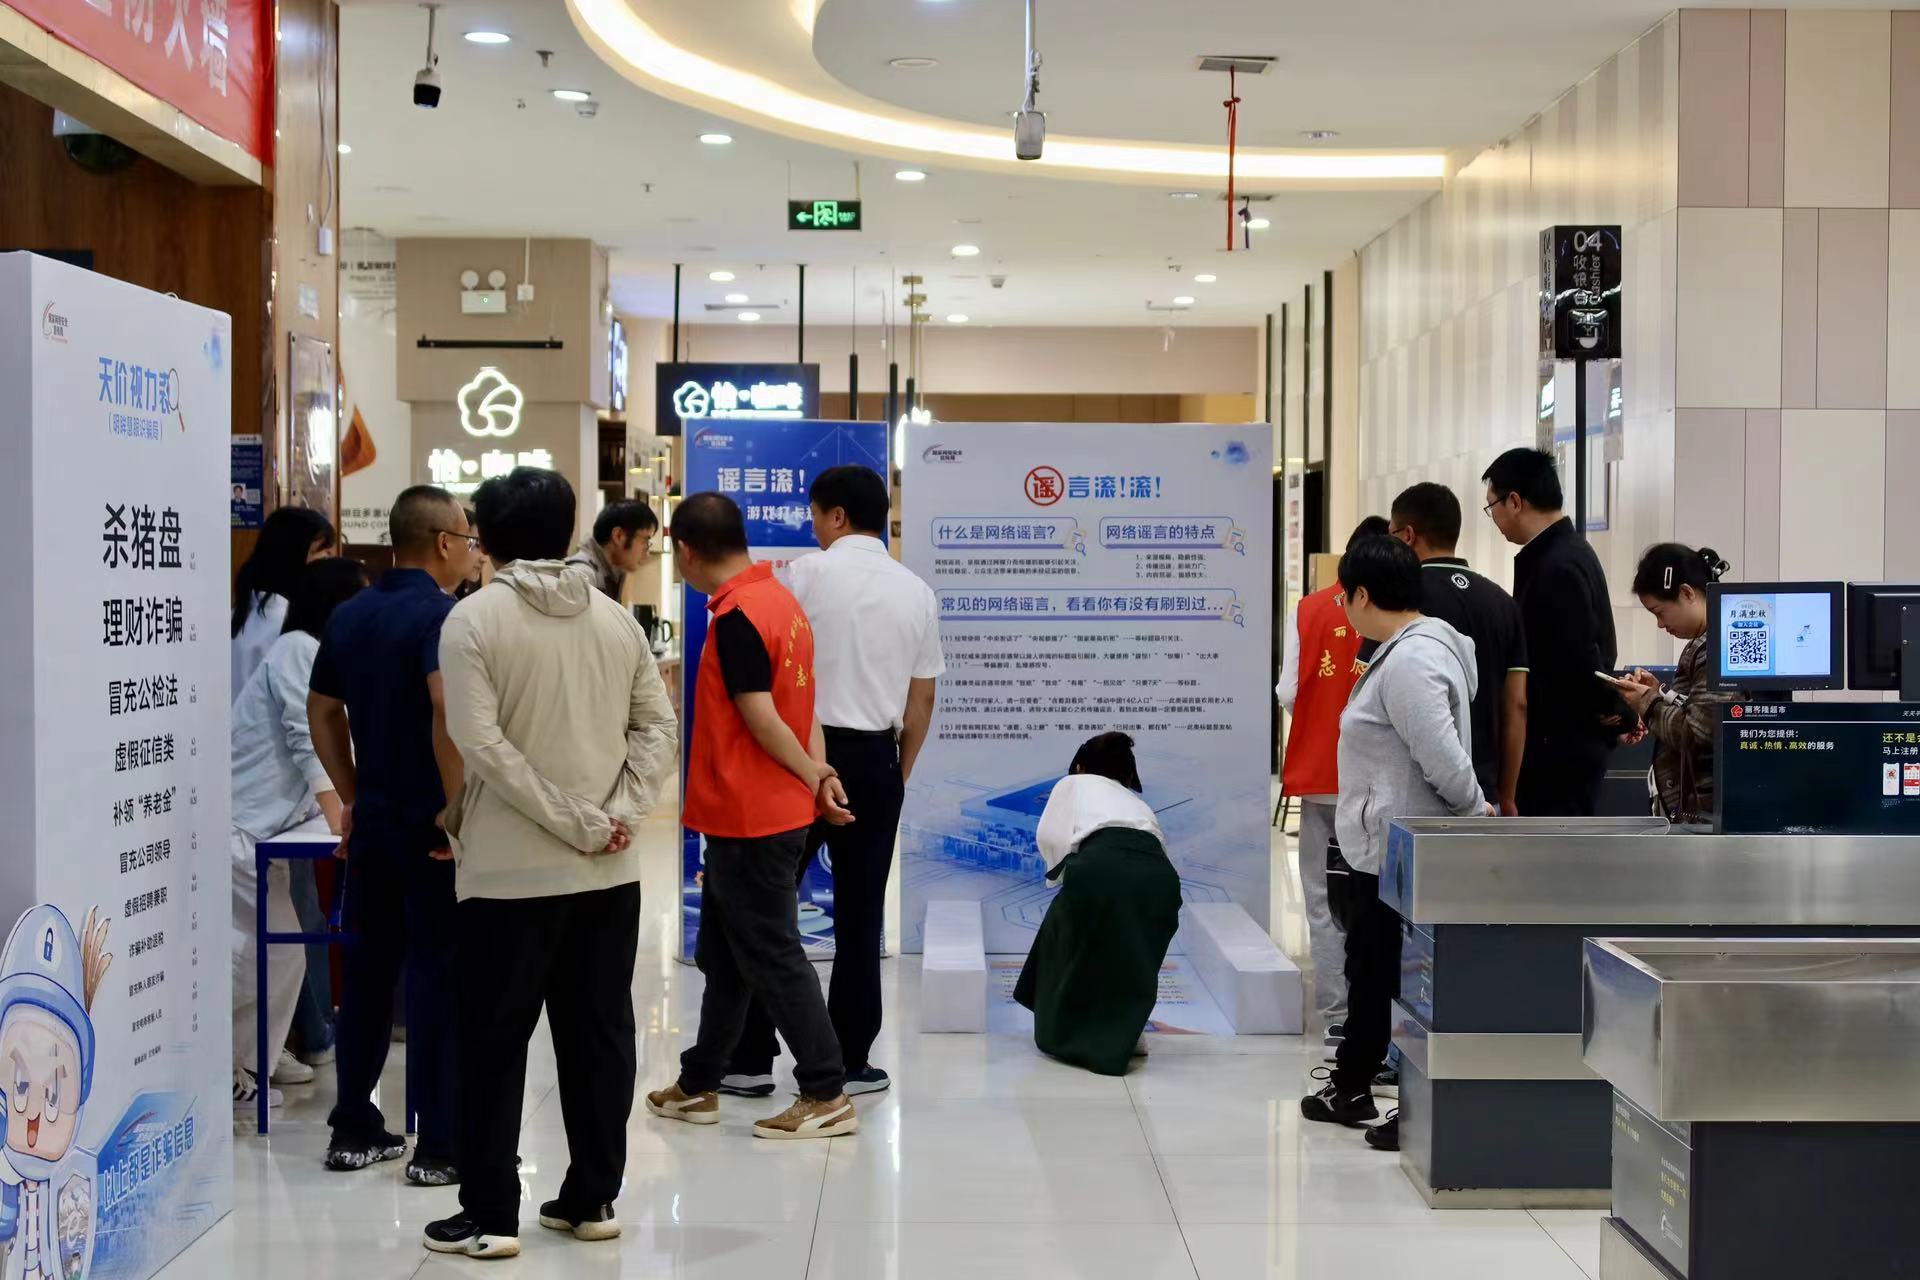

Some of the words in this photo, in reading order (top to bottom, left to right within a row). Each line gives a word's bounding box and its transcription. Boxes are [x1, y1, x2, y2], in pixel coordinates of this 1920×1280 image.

[1573, 230, 1602, 252] 04
[98, 357, 170, 414] 天价视力表
[717, 467, 805, 493] 谣言滚！
[102, 503, 182, 570] 杀猪盘
[938, 524, 1056, 540] 什么是网络谣言？
[1106, 524, 1216, 540] 网络谣言的特点
[102, 596, 183, 647] 理财诈骗
[108, 674, 178, 716] 冒充公检法
[1740, 729, 1799, 738] 我们为您提供：
[1740, 741, 1834, 751] 真诚、热情、高效的服务
[115, 734, 174, 773] 虚假征信类
[1882, 746, 1918, 755] 马上注册
[113, 785, 177, 828] 补领“养老金”
[119, 839, 171, 875] 冒充公司领导
[124, 887, 168, 918] 虚假招聘兼职
[103, 1114, 194, 1212] 以上都是诈骗信息
